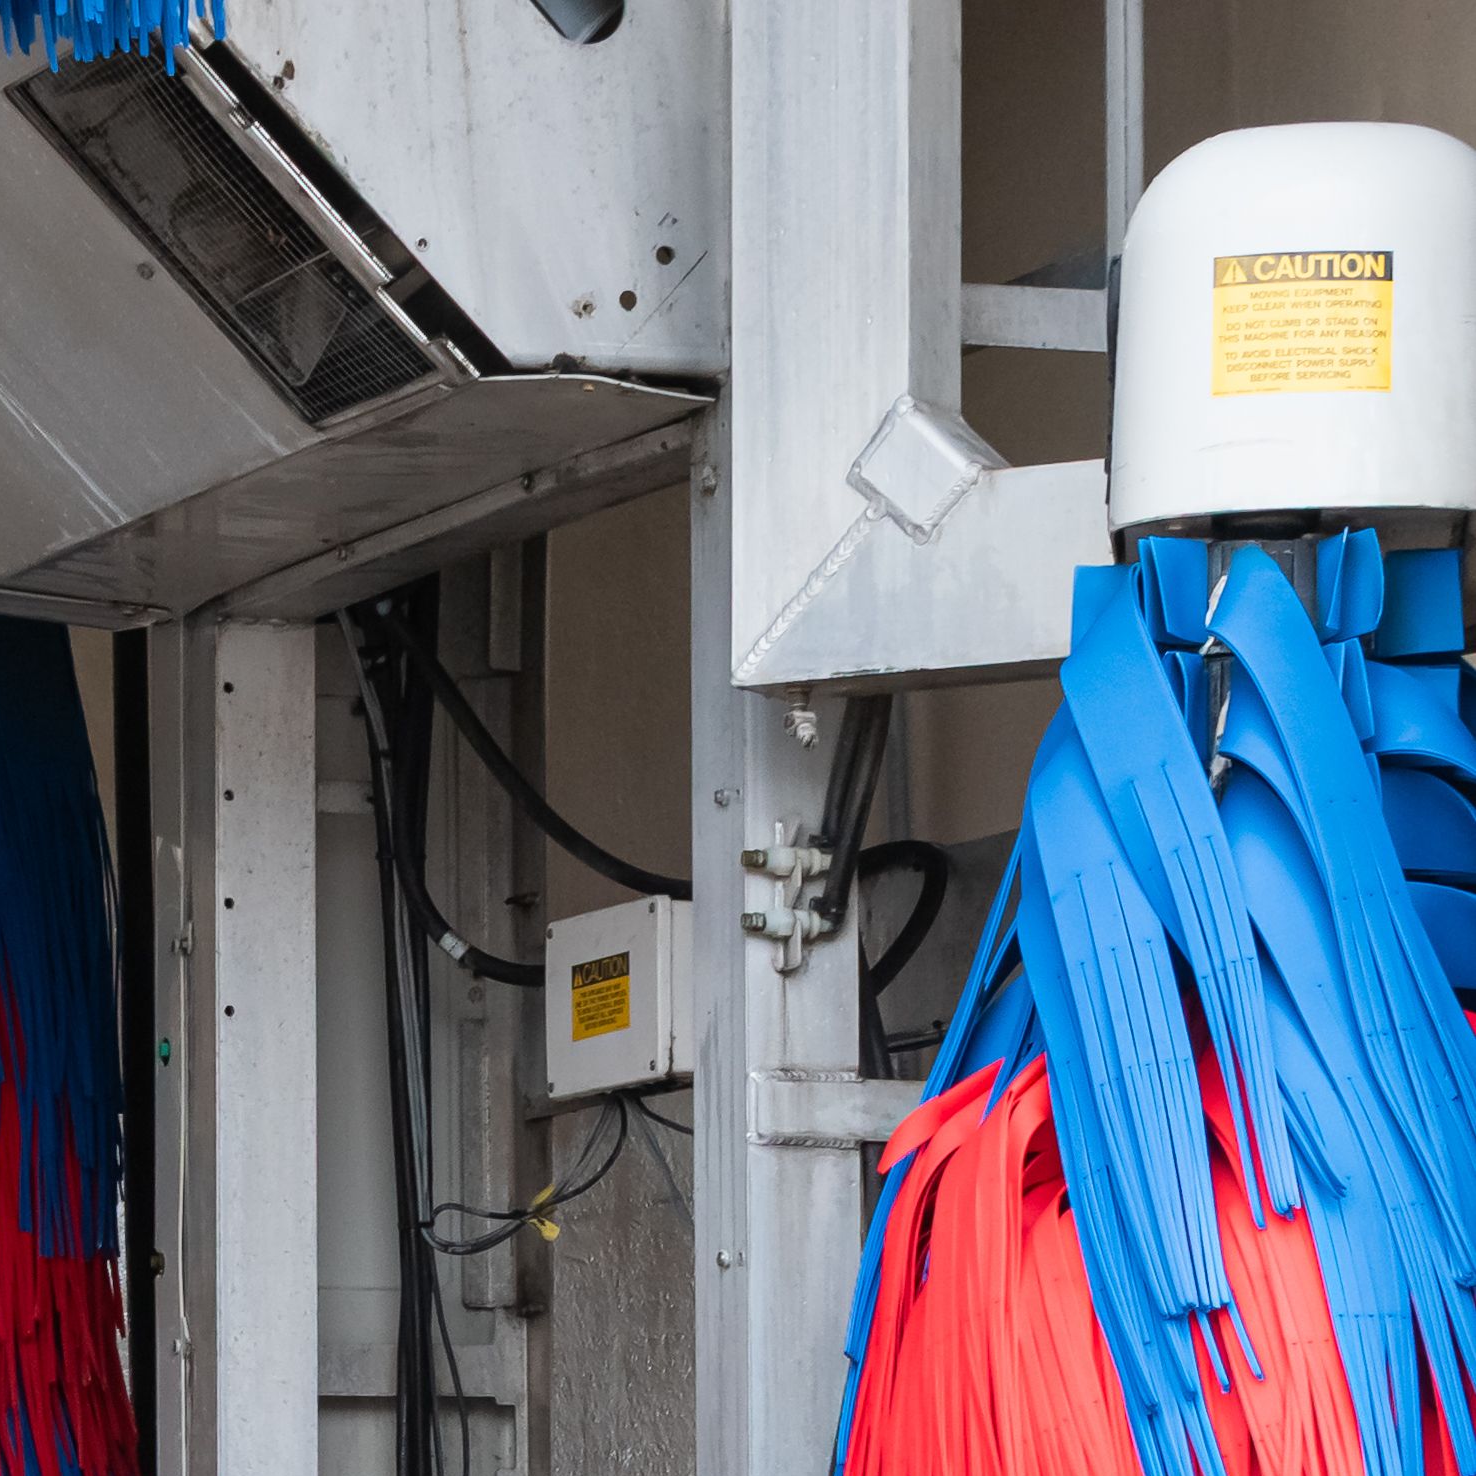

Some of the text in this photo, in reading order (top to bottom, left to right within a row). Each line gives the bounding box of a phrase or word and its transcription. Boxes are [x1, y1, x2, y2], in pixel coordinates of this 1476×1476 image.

[1253, 253, 1385, 281] CAUTION
[1250, 288, 1355, 299] MOVING EQUIPMENT
[1223, 300, 1383, 313] KEEP CLEAR WHEN OPERATING
[1226, 317, 1378, 331] DO NOT CLIMB OR STAND ON
[1218, 330, 1387, 343] THIS MACHINE FOR ANY REASON
[1224, 346, 1379, 361] TO AVOID ELECTRICAL SHOCK
[1226, 359, 1376, 373] DISCONNECT POWER SUPPLY
[1250, 370, 1352, 382] BEFORE SERVICING
[583, 955, 627, 984] CAUTION
